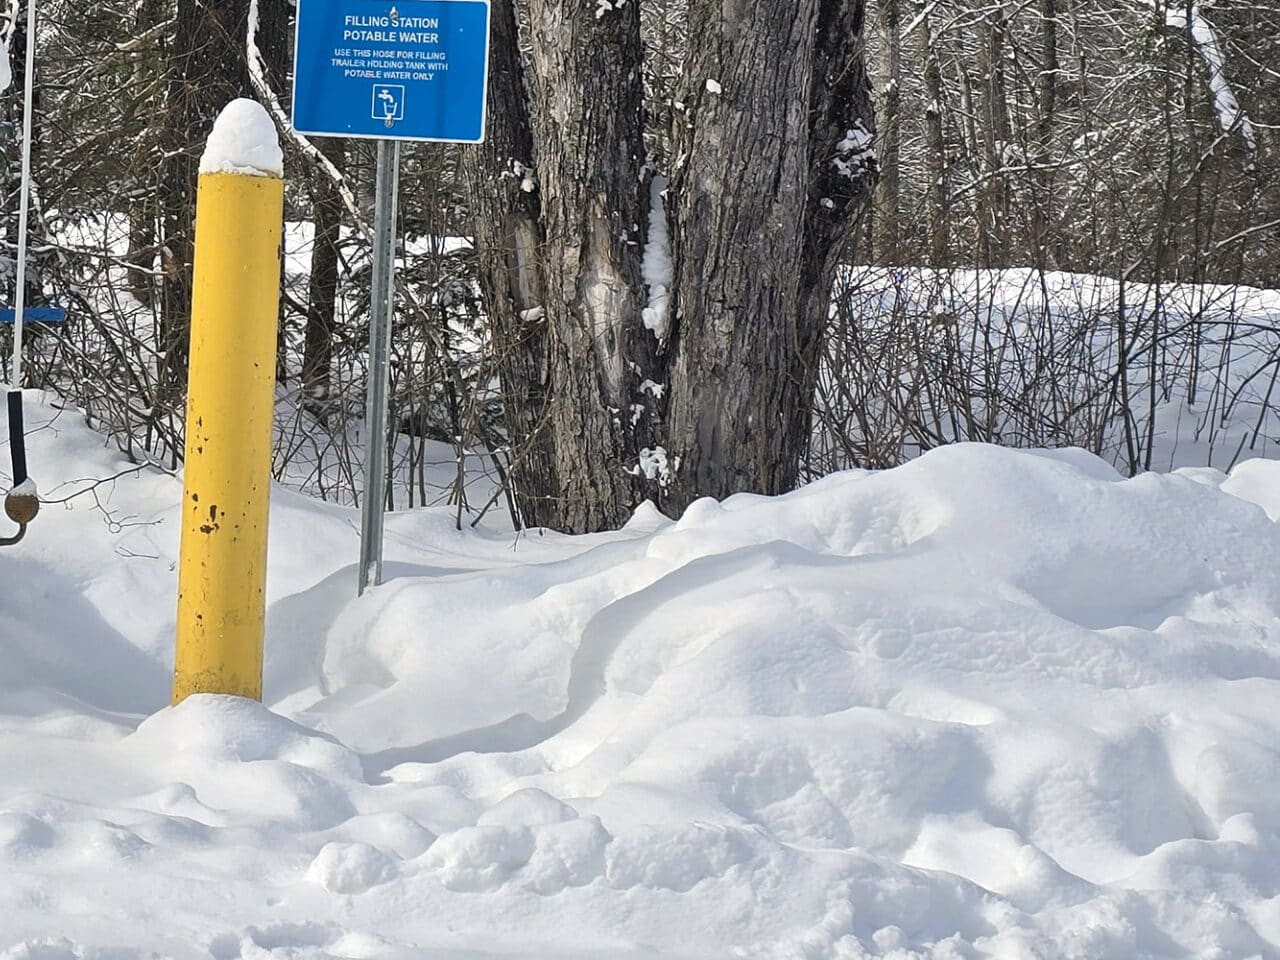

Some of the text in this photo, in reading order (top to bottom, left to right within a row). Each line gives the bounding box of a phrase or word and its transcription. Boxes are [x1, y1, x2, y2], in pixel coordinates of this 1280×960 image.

[345, 16, 438, 28] FILLING STATION
[344, 30, 438, 43] POTABLE WATER
[416, 52, 445, 60] FILLING
[331, 59, 365, 67] TRAILER
[368, 60, 403, 69] HOLDING
[405, 62, 426, 70] TANK
[344, 70, 381, 78] POTABLE
